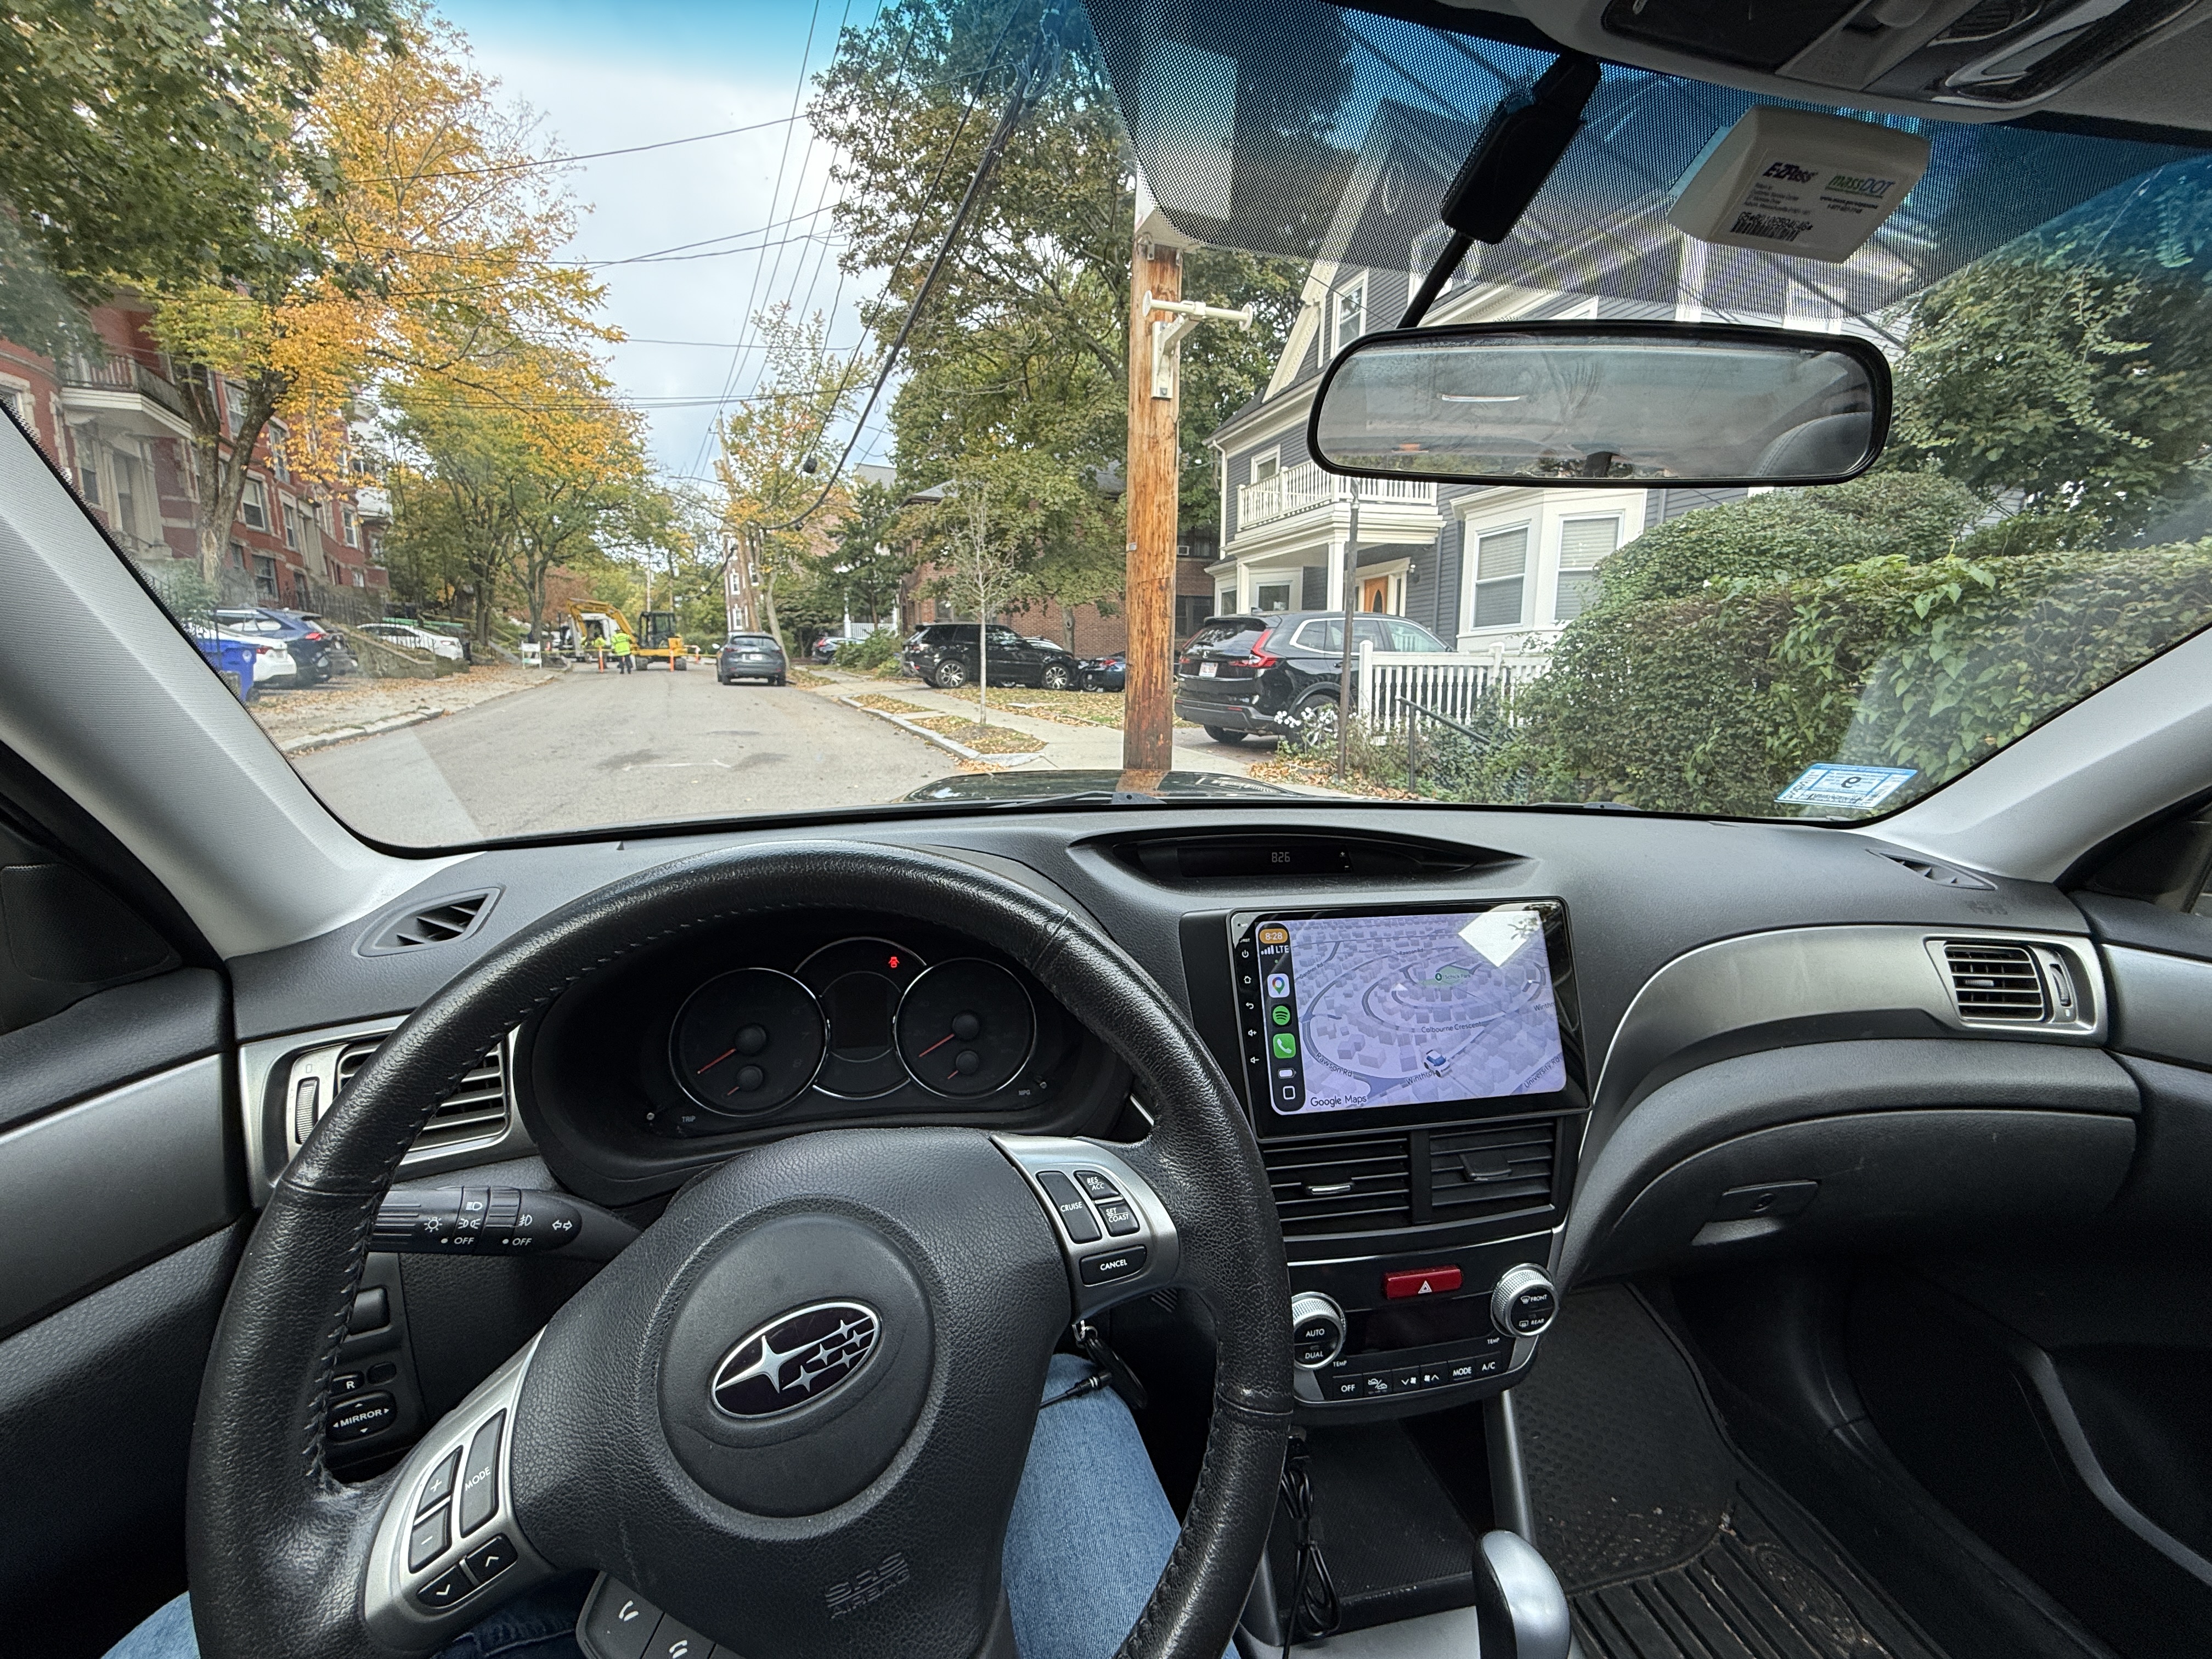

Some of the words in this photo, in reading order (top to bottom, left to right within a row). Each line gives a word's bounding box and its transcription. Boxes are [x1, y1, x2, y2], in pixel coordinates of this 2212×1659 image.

[1265, 932, 1283, 940] 8:28
[1276, 945, 1289, 953] LTE
[1300, 967, 1317, 979] Gardner
[1454, 1022, 1482, 1030] Crescent
[1316, 1052, 1341, 1074] Rawson
[1343, 1068, 1353, 1077] Rd
[1523, 1063, 1552, 1088] University
[1551, 1054, 1560, 1065] Rd
[1310, 1095, 1342, 1108] Google
[1345, 1094, 1367, 1105] Maps
[1087, 1176, 1099, 1184] RES
[1091, 1182, 1105, 1190] ACC
[1060, 1201, 1083, 1212] CRUISE
[1106, 1207, 1117, 1215] SET
[1108, 1212, 1129, 1223] COAST
[454, 1237, 475, 1245] OFF
[512, 1238, 532, 1246] OFF
[1100, 1259, 1127, 1271] CANCEL
[1530, 1294, 1548, 1302] FRONT
[1306, 1328, 1325, 1338] AUTO
[1305, 1351, 1324, 1359] DUAL
[1481, 1361, 1496, 1371] A/C
[1453, 1366, 1472, 1376] MODE
[346, 1380, 356, 1389] R
[1341, 1384, 1356, 1392] OFF
[340, 1408, 382, 1427] MIRROR
[464, 1466, 491, 1492] MODE
